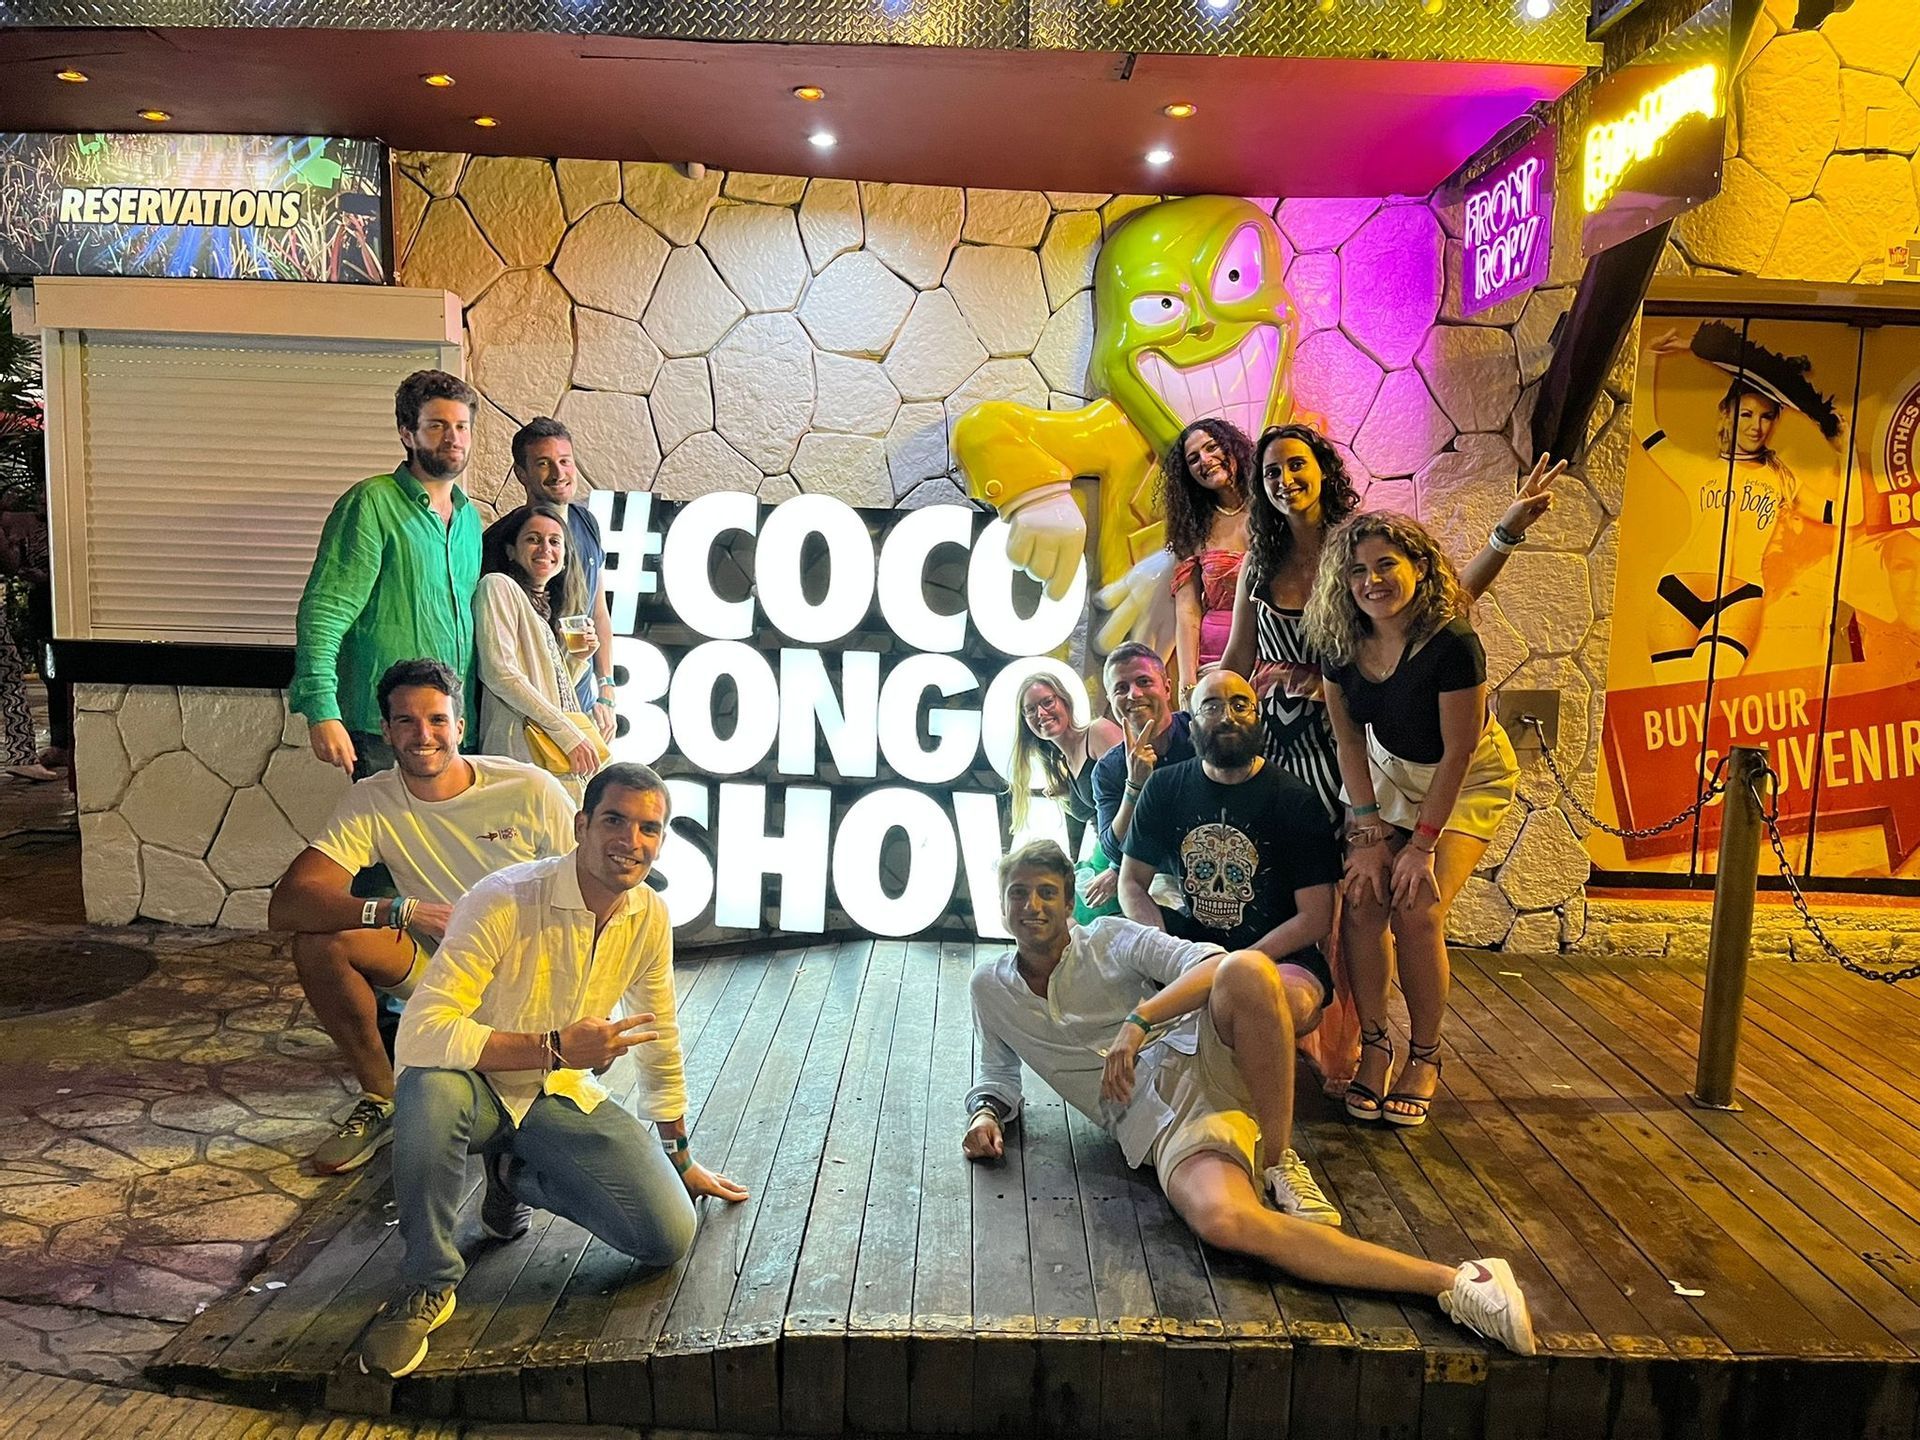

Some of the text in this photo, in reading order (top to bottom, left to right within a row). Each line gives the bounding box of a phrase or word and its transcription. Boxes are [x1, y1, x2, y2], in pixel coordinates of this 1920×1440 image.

[59, 188, 302, 228] RESERVATIONS
[1464, 156, 1540, 250] FRONT
[1892, 404, 1920, 488] CLOTHES
[588, 489, 1088, 656] #COCO
[1643, 687, 1810, 751] BUY YOUR
[1694, 719, 1920, 807] SUVENIR
